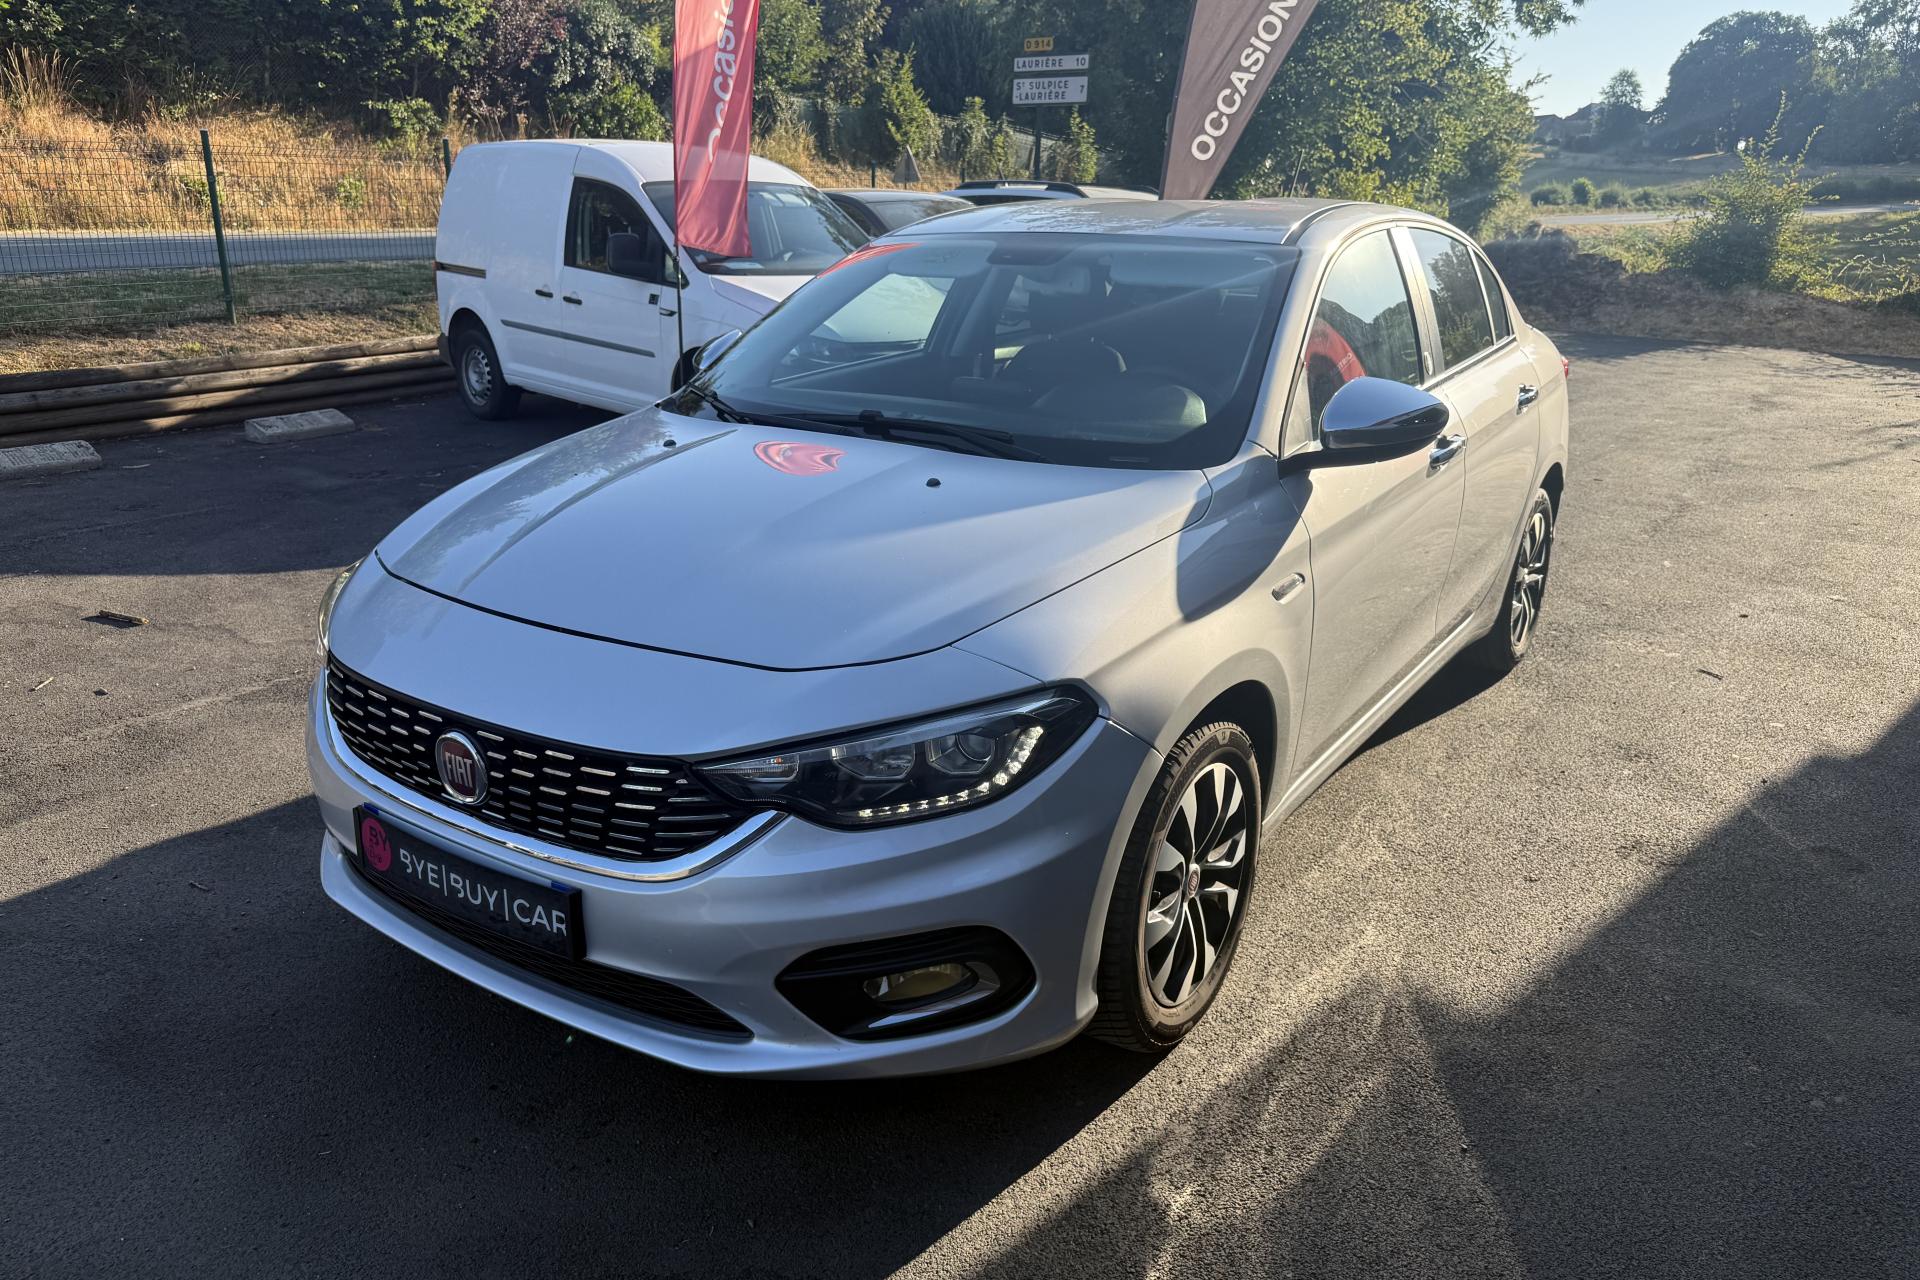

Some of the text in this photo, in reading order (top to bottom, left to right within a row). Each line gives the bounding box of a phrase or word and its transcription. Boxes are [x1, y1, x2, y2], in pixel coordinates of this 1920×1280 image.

[1034, 39, 1051, 49] 914
[1076, 57, 1086, 66] 10
[1029, 80, 1069, 90] SULPICE
[1191, 0, 1298, 161] OCCASION
[1079, 85, 1085, 94] 7
[445, 751, 472, 789] FIAT
